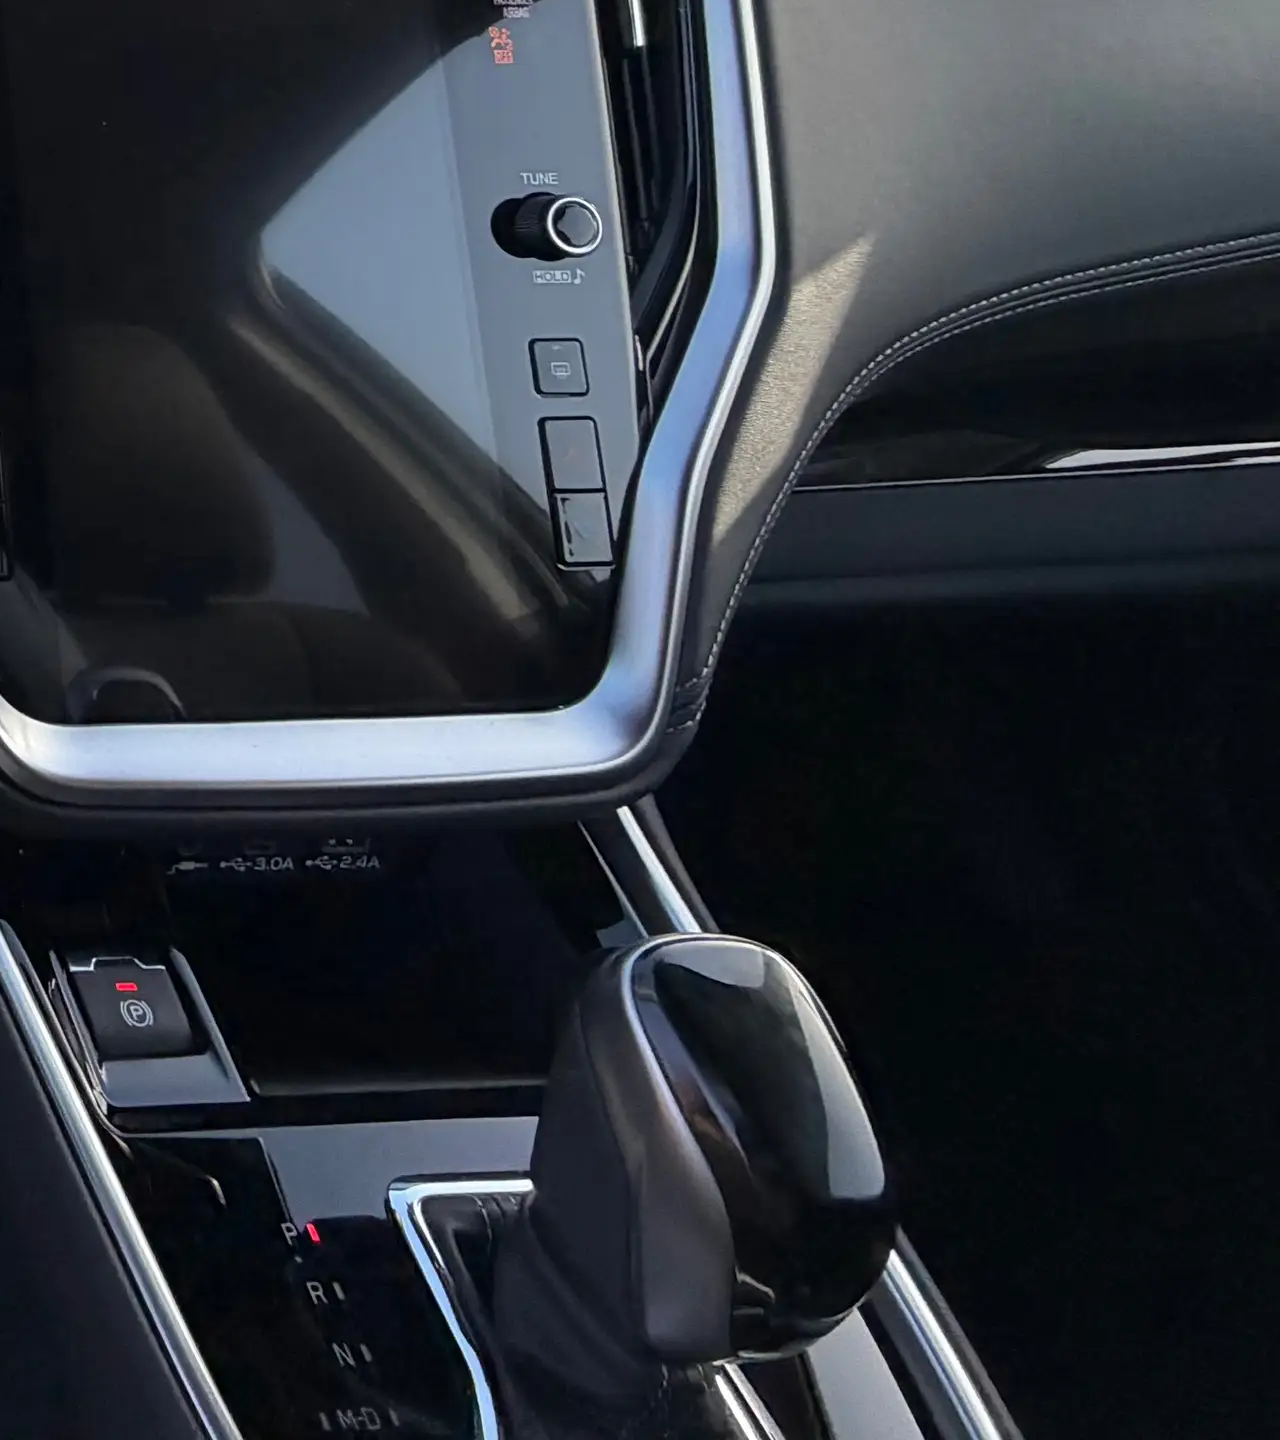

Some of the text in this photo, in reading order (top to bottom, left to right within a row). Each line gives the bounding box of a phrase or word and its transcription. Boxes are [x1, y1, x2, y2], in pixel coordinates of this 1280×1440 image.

[520, 171, 559, 185] TUNE
[533, 271, 570, 283] HOLD
[280, 1221, 297, 1246] P
[306, 1281, 328, 1305] R
[333, 1342, 356, 1367] N
